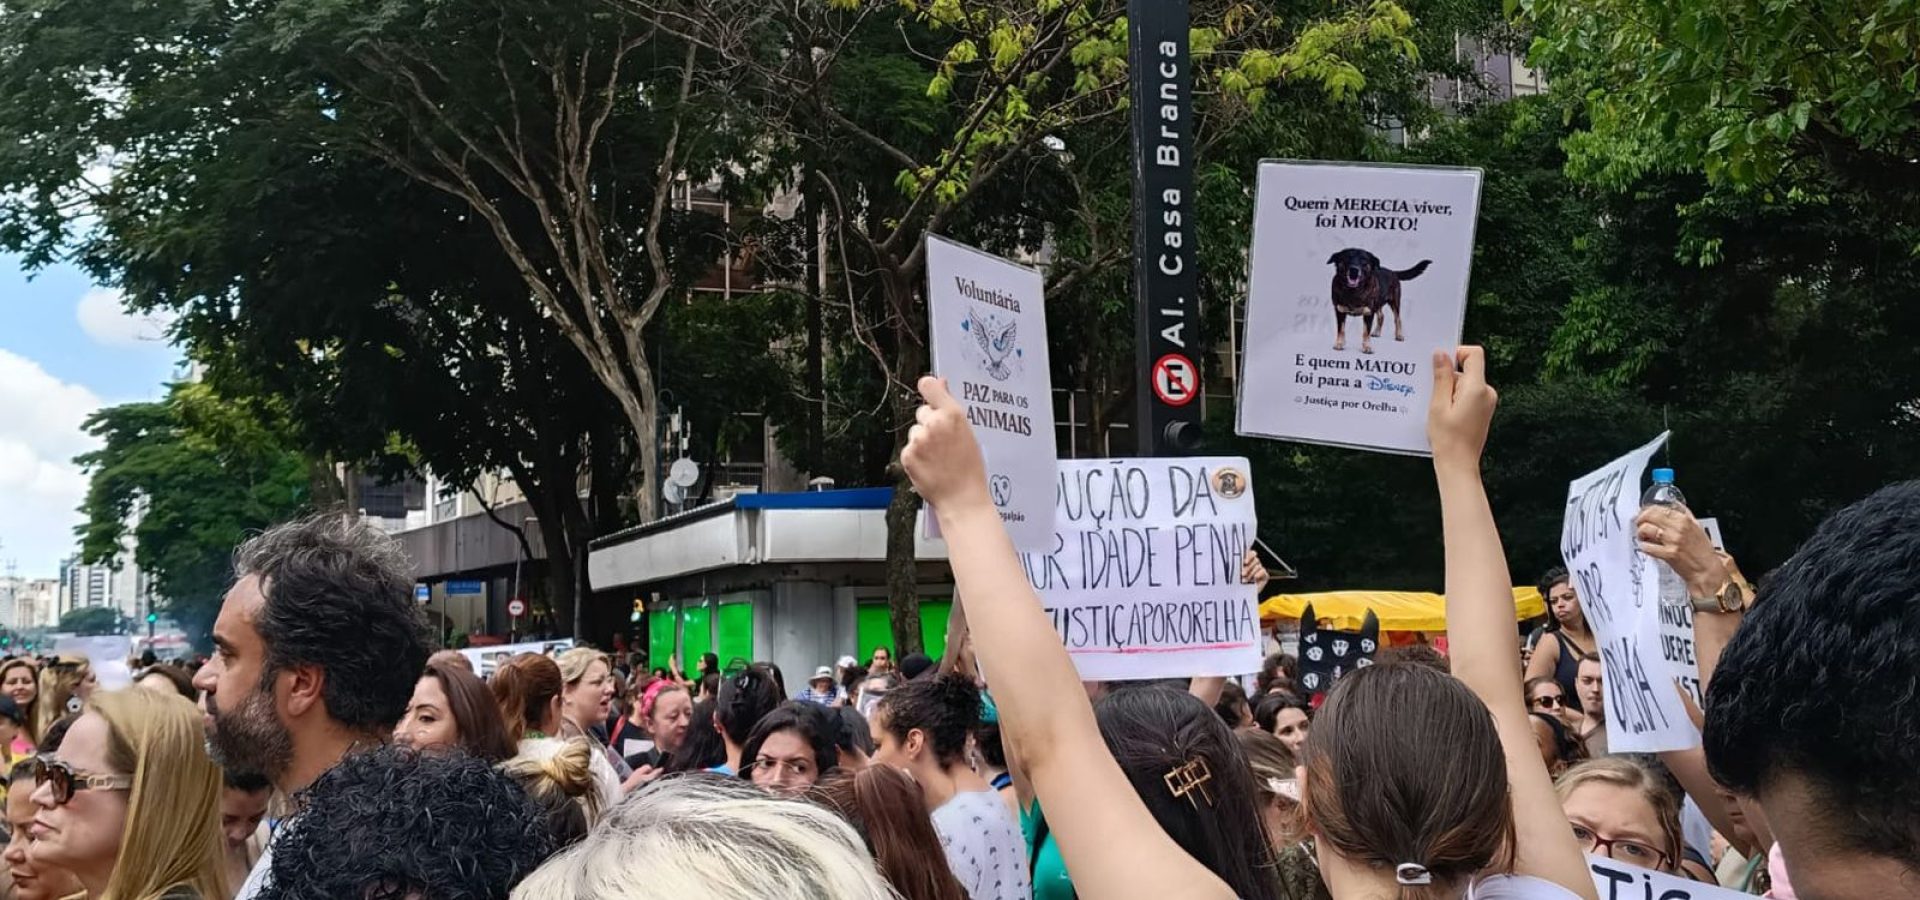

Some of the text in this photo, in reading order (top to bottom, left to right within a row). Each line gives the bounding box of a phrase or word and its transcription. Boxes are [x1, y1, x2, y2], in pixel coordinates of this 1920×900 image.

[1156, 41, 1186, 348] Al. Casa Branca
[1284, 196, 1452, 216] Quem MERECIA viver,
[1315, 213, 1418, 231] foi MORTO!
[955, 276, 1021, 313] Voluntária
[1295, 353, 1416, 376] E quem MATOU
[1295, 371, 1313, 384] foi
[1318, 374, 1349, 388] para
[1354, 379, 1362, 388] a
[963, 381, 1029, 409] PAZ PARA OS
[1304, 395, 1397, 412] Justiça por Orelha
[966, 405, 1032, 436] ANIMAIS
[1056, 460, 1218, 530] UÇÃO DA
[1080, 527, 1162, 588] IDADE
